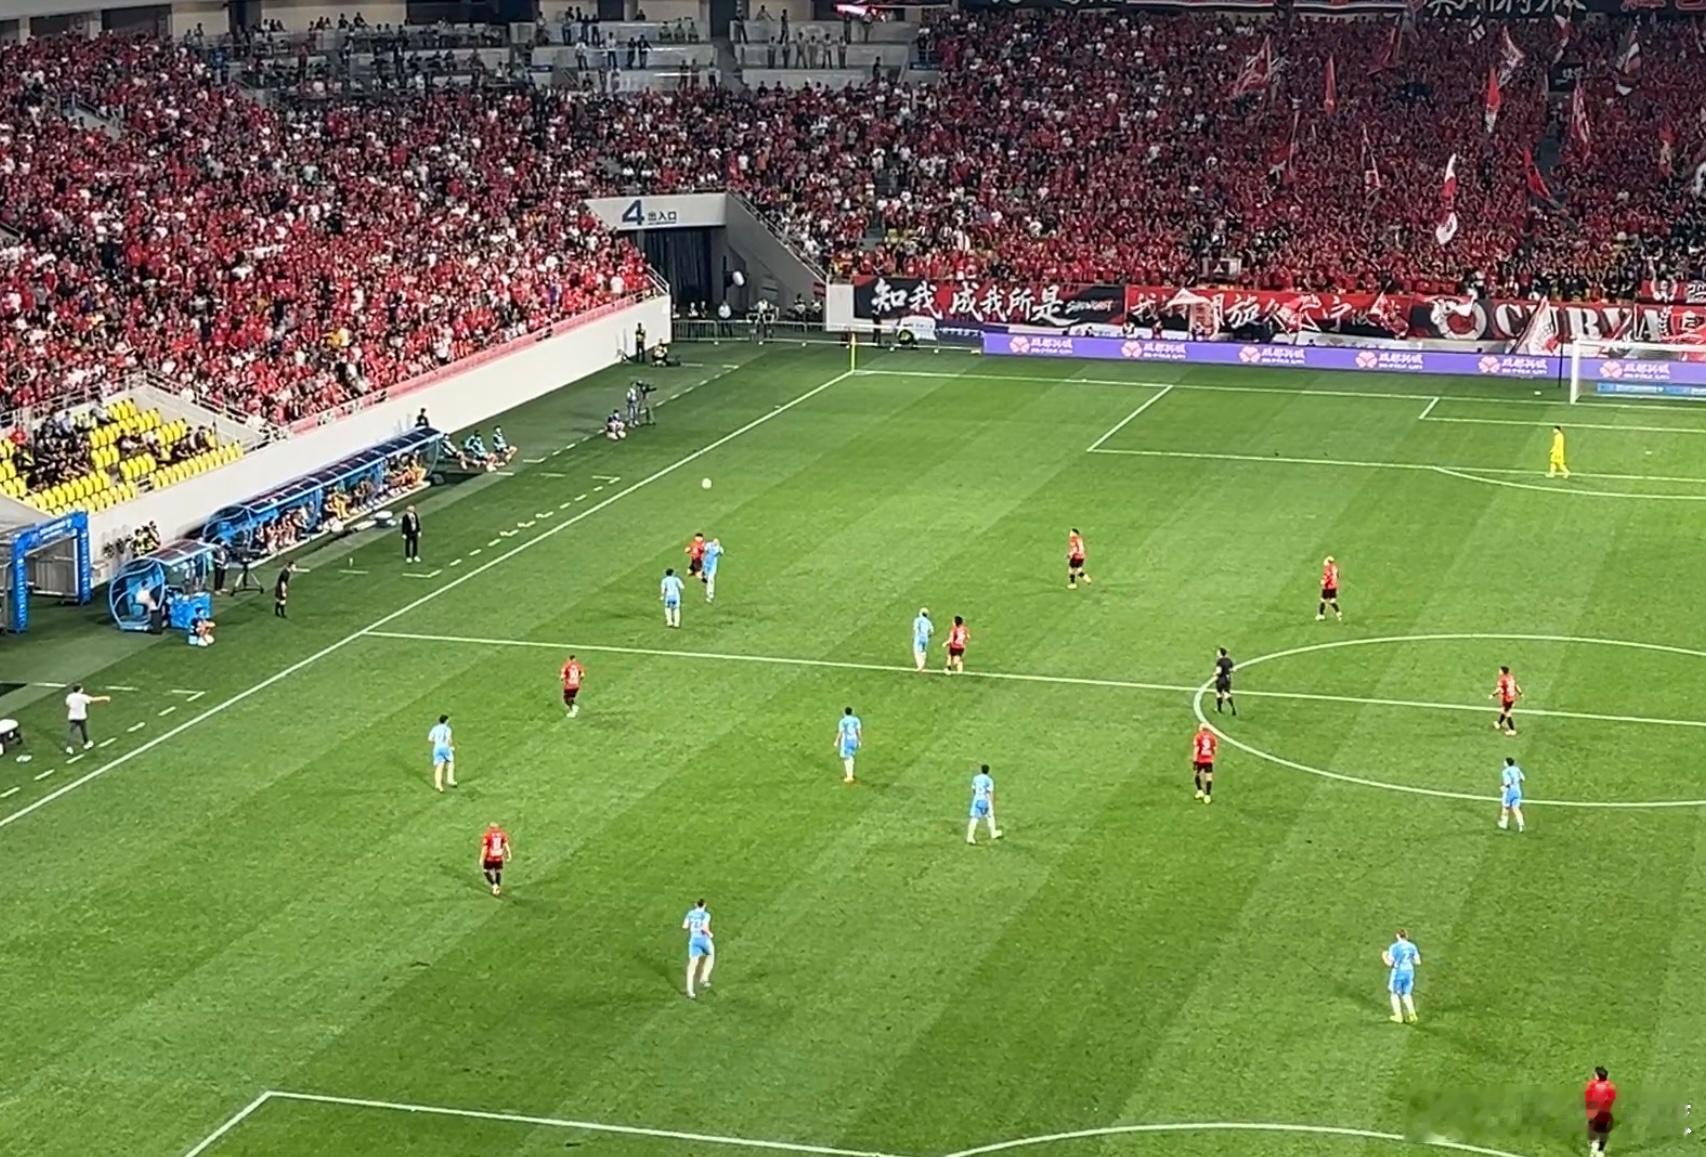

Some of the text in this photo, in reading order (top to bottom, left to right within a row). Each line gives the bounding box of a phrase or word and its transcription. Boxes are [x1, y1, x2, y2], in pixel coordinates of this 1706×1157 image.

[622, 199, 645, 225] 4
[647, 210, 677, 221] 出入口
[872, 277, 942, 320] 知我
[950, 281, 1080, 325] 成我所是
